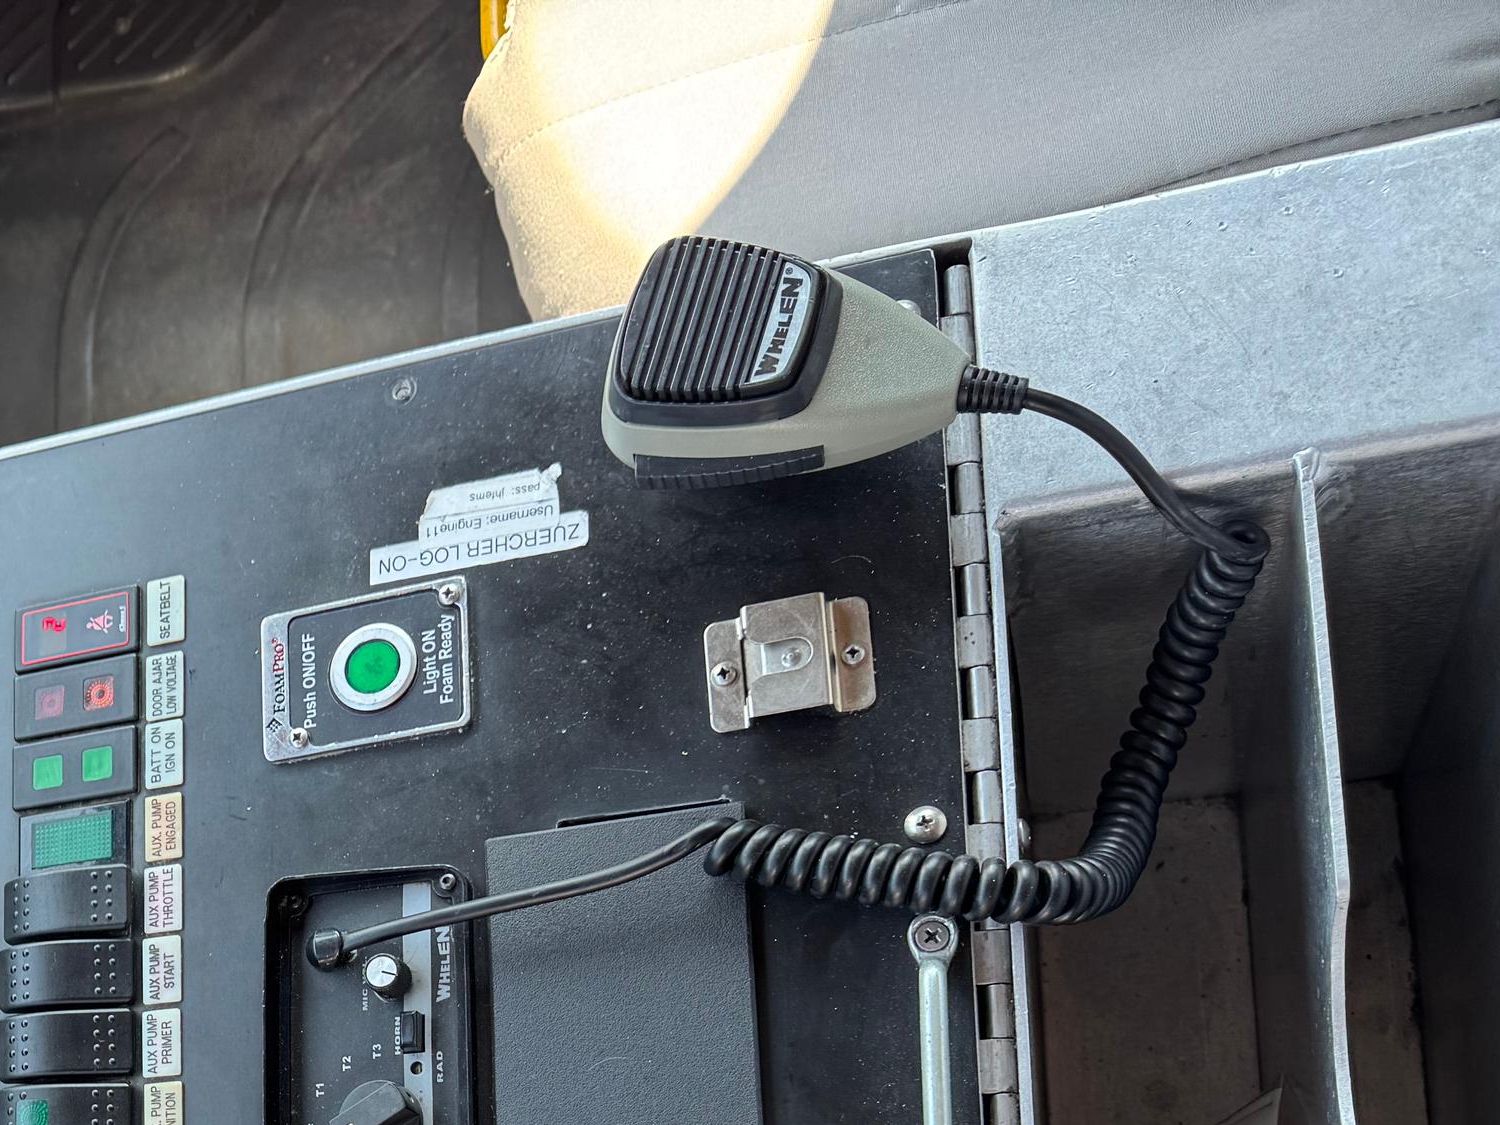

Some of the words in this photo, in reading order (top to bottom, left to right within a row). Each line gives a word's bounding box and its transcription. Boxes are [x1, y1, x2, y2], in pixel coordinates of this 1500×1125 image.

[426, 517, 483, 539] Engine11
[486, 504, 554, 527] Username:
[467, 522, 580, 558] ZUERCHER
[378, 545, 460, 575] LOG-ON
[159, 580, 171, 640] SEATBELT
[421, 629, 436, 652] ON
[437, 614, 456, 662] Ready
[151, 656, 163, 683] AJAR
[165, 654, 177, 693] VOLTAGE
[301, 632, 317, 689] ON/OFF
[422, 662, 441, 695] Light
[439, 664, 454, 705] Foam
[151, 684, 163, 717] DOOR
[165, 693, 177, 715] LOW
[303, 693, 318, 730] Push
[151, 726, 161, 744] ON
[164, 731, 175, 748] ON
[150, 743, 162, 784] BATT
[164, 753, 176, 773] IGN
[151, 798, 162, 831] PUMP
[165, 800, 176, 850] ENGAGED
[151, 832, 162, 857] AUX.
[149, 871, 159, 905] PUMP
[162, 867, 174, 928] THROTTLE
[149, 907, 159, 928] AUX
[149, 943, 160, 977] PUMP
[163, 952, 175, 989] START
[435, 925, 451, 1003] WHELEN
[149, 979, 160, 1001] AUX
[146, 1013, 158, 1046] PUMP
[161, 1019, 173, 1065] PRIMER
[146, 1053, 158, 1074] AUX
[342, 1055, 352, 1072] T2
[372, 1043, 382, 1059] T3
[436, 1050, 444, 1083] RAD
[151, 1085, 163, 1117] PUMP
[315, 1083, 325, 1098] T1
